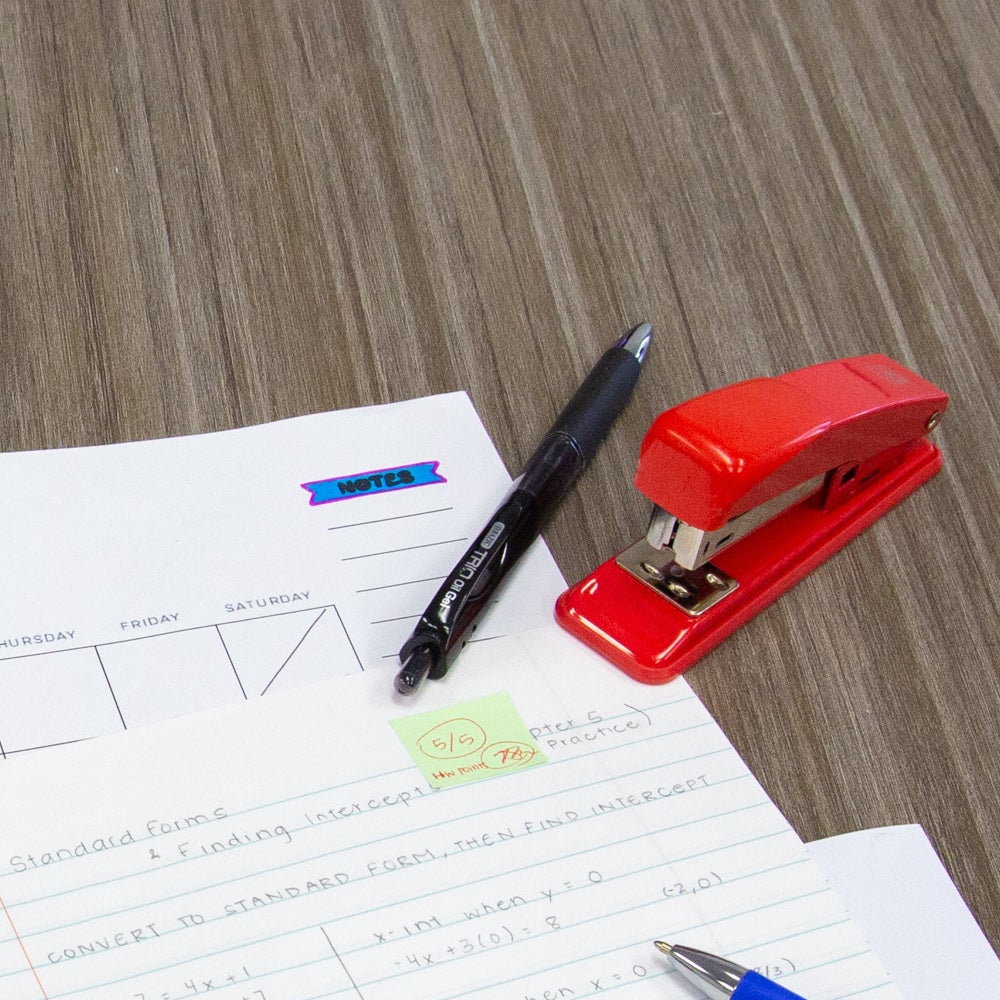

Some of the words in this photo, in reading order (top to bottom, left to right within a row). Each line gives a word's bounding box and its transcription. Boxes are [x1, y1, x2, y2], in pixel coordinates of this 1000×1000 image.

[337, 470, 415, 494] NOTES
[120, 613, 180, 631] FRIDAY
[225, 592, 311, 613] SATURDAY
[432, 732, 474, 752] 5/5
[11, 830, 136, 873] Standard
[178, 825, 291, 857] Finding
[48, 923, 160, 964] CONVERT
[178, 914, 204, 928] TO
[224, 872, 350, 917] STANDARD
[454, 828, 513, 852] THEN
[525, 810, 578, 835] FIND
[464, 895, 526, 920] when
